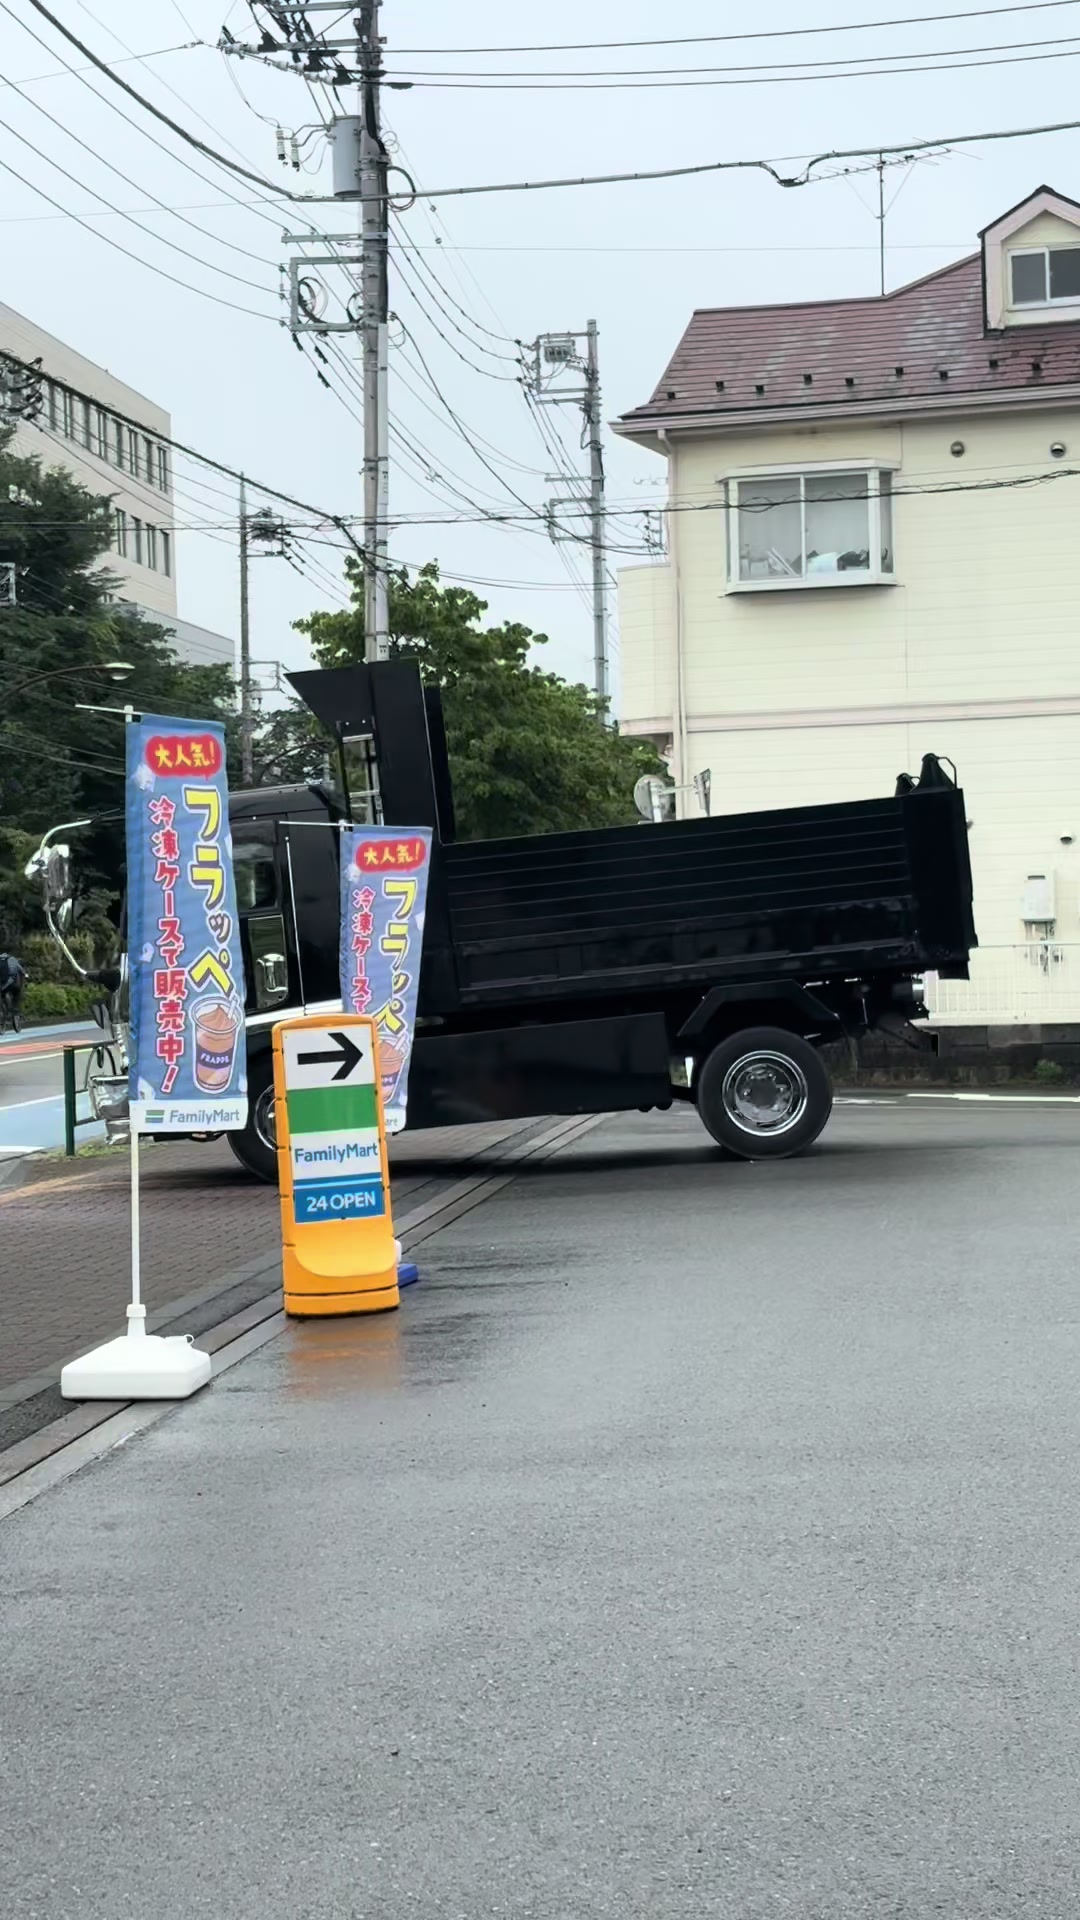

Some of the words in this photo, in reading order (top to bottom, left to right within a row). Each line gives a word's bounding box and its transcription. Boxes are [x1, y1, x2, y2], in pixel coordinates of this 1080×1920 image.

[154, 741, 215, 768] 大人気!
[363, 842, 420, 866] 大人気!
[181, 784, 236, 998] フラッペ
[149, 795, 188, 1093] 冷凍ケースで販売中!
[169, 1109, 240, 1125] FamilyMart
[294, 1142, 379, 1164] FamilyMart
[306, 1195, 328, 1212] 24
[329, 1190, 377, 1210] OPEN
